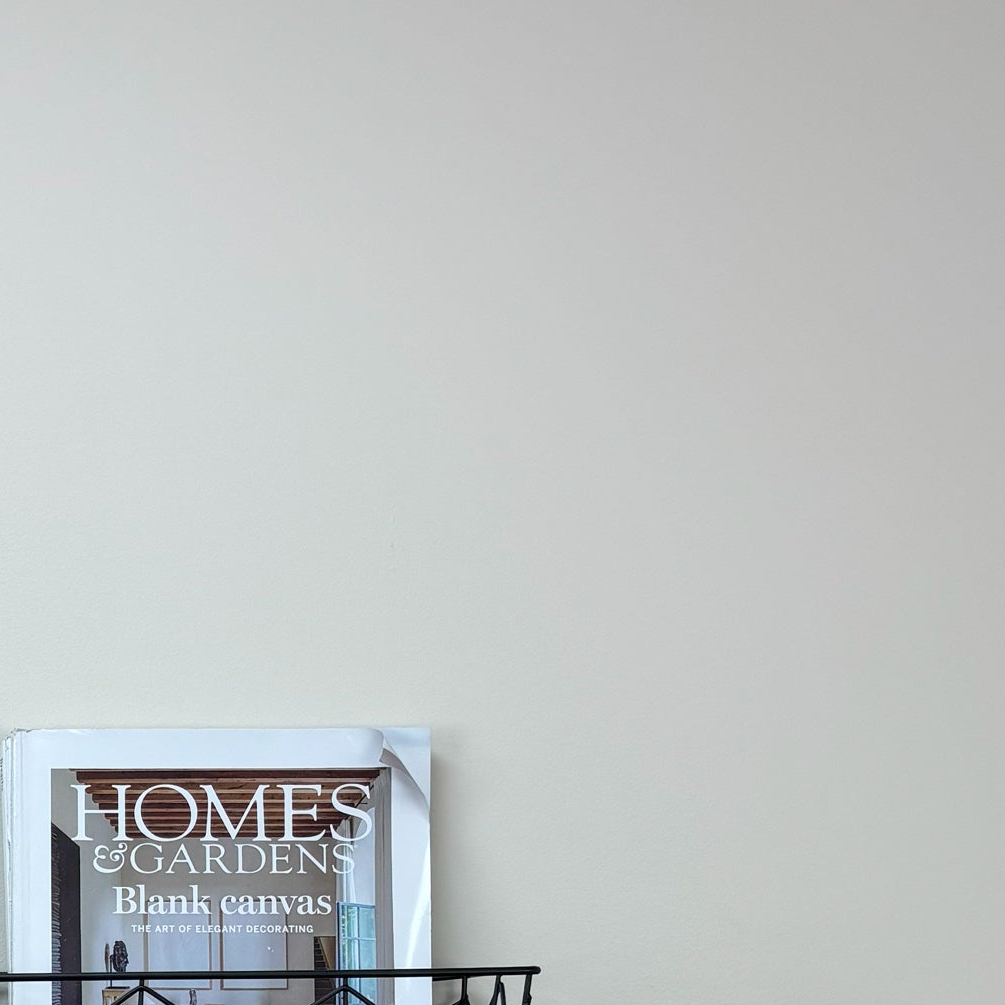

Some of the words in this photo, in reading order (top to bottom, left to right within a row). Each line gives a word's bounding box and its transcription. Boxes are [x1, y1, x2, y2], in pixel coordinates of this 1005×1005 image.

[70, 784, 373, 842] HOMES
[112, 885, 212, 915] Blank
[220, 893, 332, 916] canvas
[131, 924, 151, 934] THE
[154, 924, 175, 934] ART
[178, 924, 192, 934] OF
[195, 924, 243, 934] ELEGANT
[246, 924, 314, 934] DECORATING
